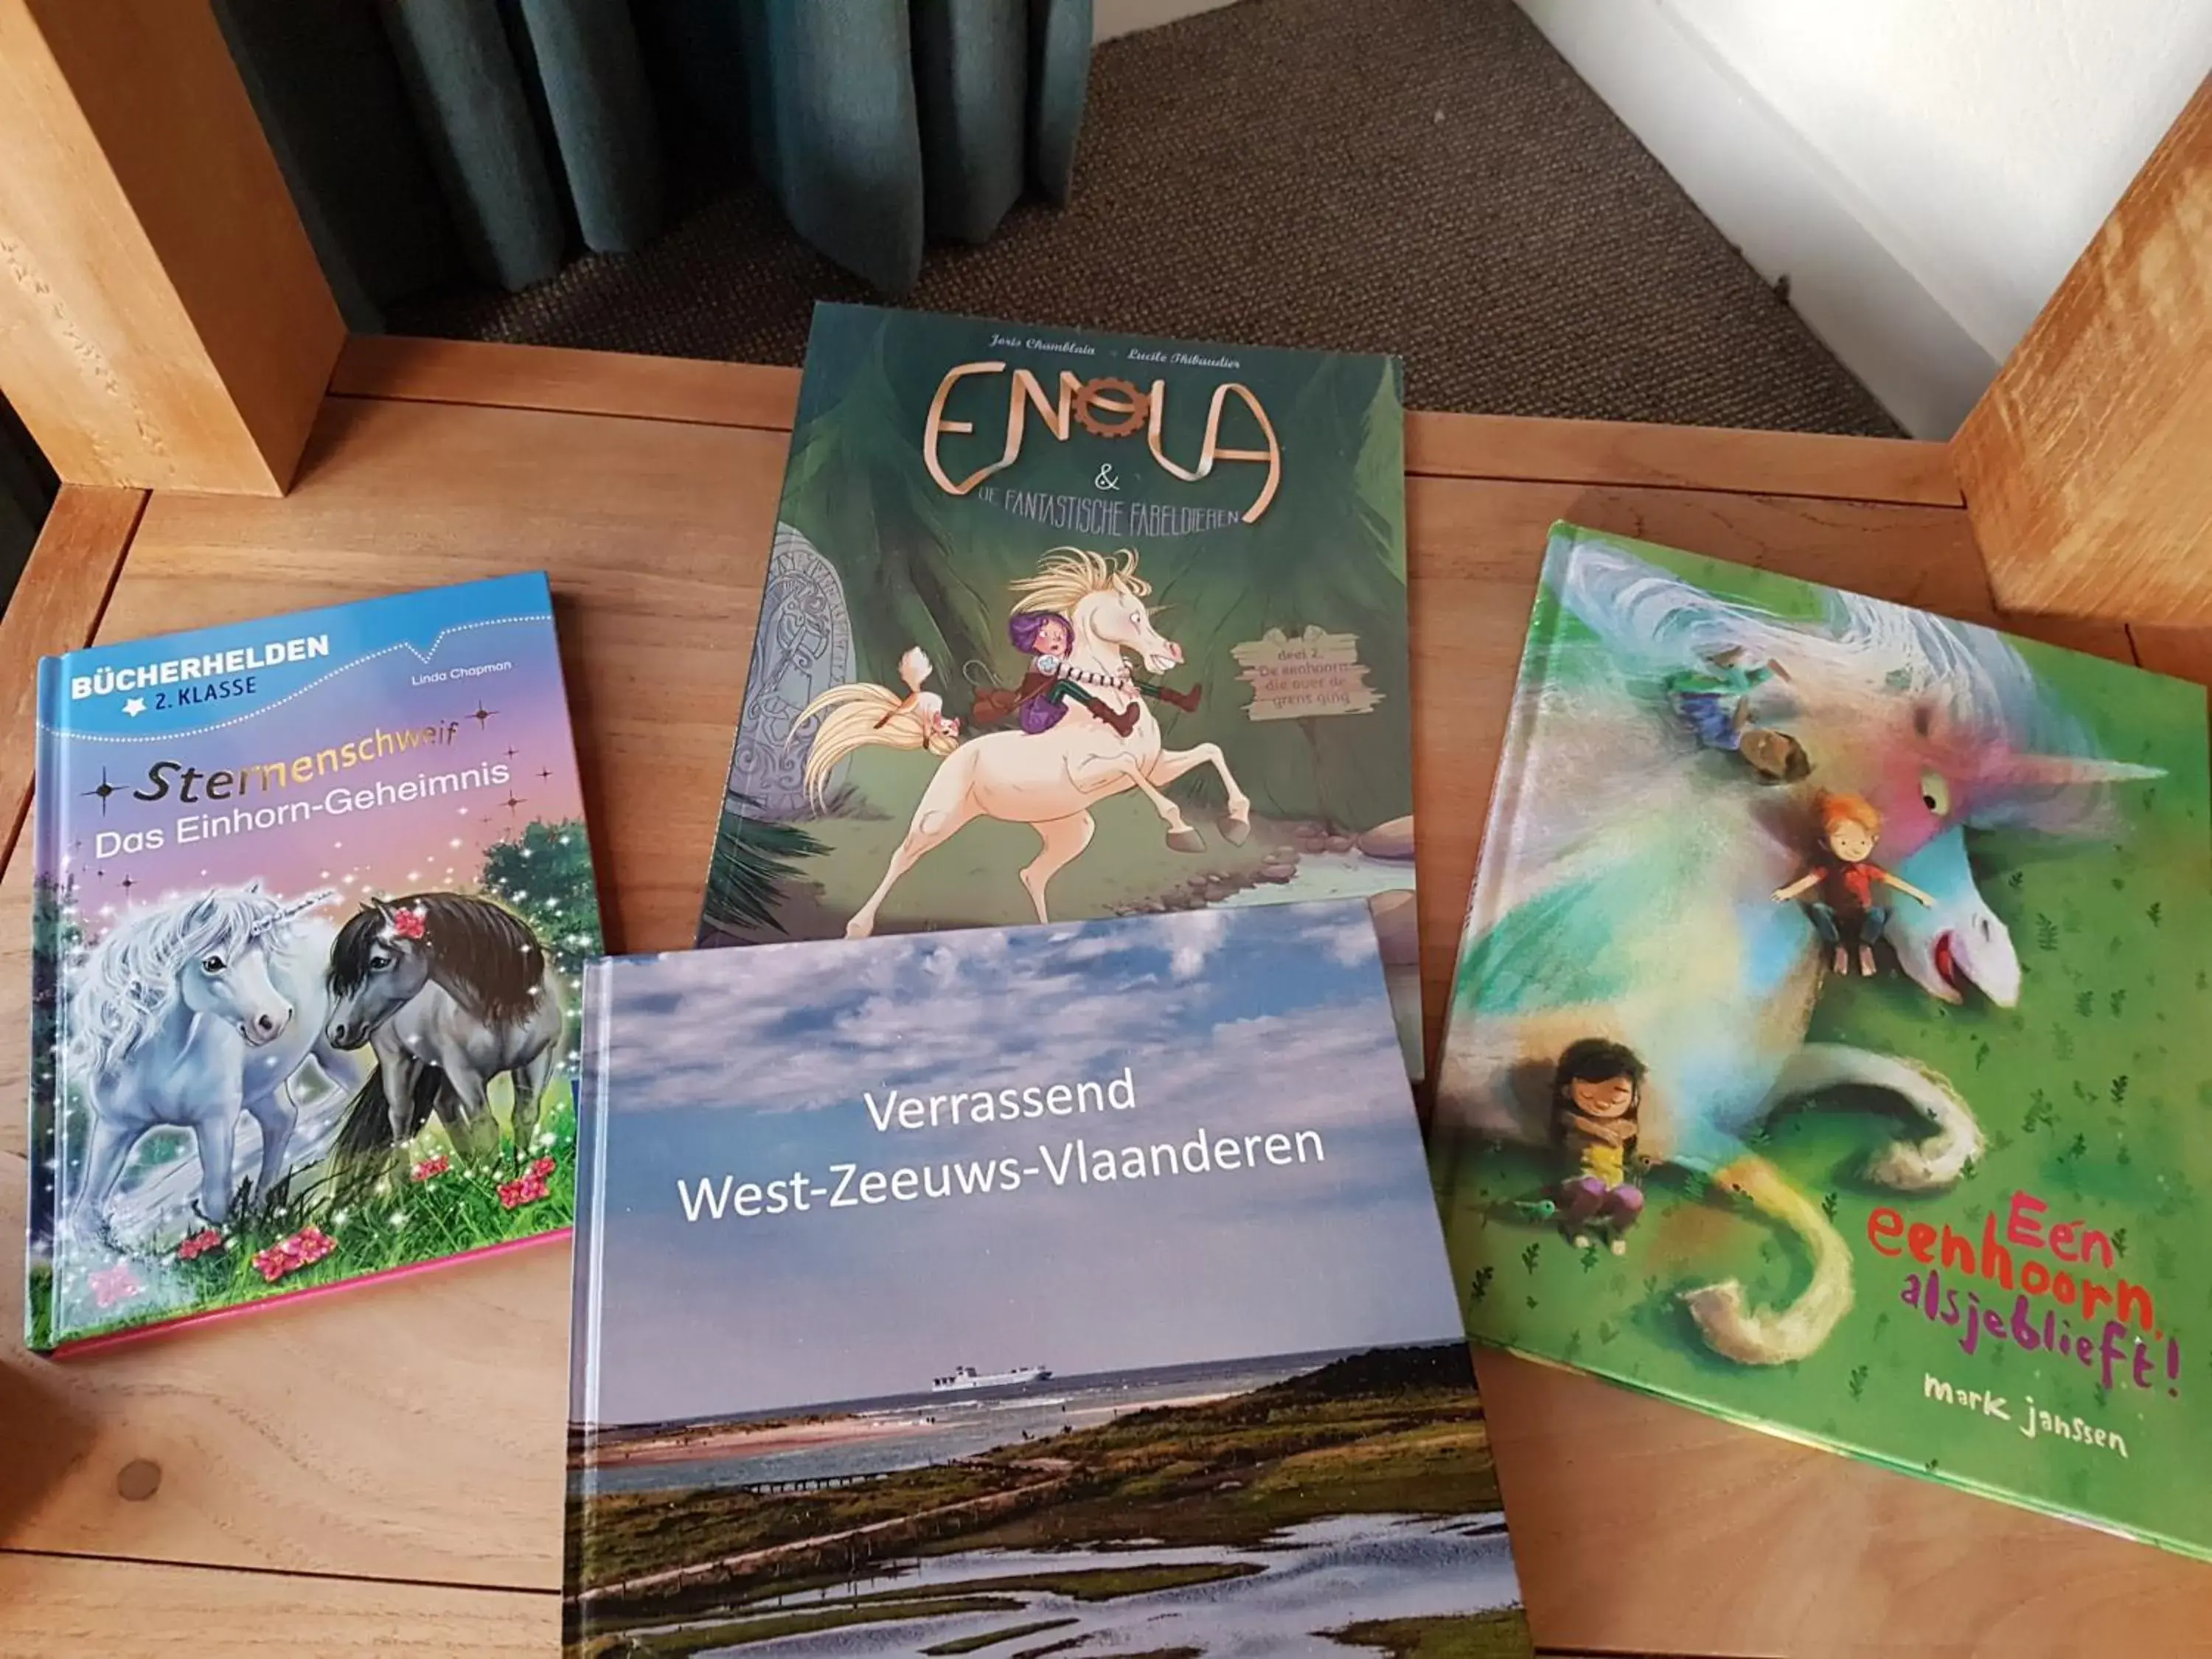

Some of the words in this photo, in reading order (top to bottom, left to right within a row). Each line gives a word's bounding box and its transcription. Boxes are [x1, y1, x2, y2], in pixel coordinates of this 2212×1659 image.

[989, 333, 1022, 348] Joris
[1026, 338, 1096, 356] Chamblain
[1127, 348, 1168, 363] Lucile
[1169, 353, 1241, 369] Thibaudier
[924, 361, 1281, 524] ENOLA
[1094, 463, 1121, 491] &
[1004, 488, 1125, 538] FANTASTISCHE
[1129, 501, 1242, 538] FABELDIEREN
[71, 634, 330, 700] BÜCHERHELDEN
[155, 692, 174, 711] 2.
[178, 675, 258, 705] KLASSE
[411, 671, 448, 686] Linda
[450, 660, 513, 679] Chapman
[1265, 678, 1287, 691] die
[133, 720, 460, 804] Sternenschweif
[94, 826, 165, 860] Das
[175, 761, 511, 844] Einhorn-Geheimnis
[863, 1067, 1136, 1133] Verrassend
[676, 1127, 1326, 1222] West-Zeeuws-Vlaanderen
[1900, 1268, 2180, 1398] alsjeblieft!
[1924, 1372, 2011, 1421] mark
[2020, 1395, 2129, 1458] janssen
